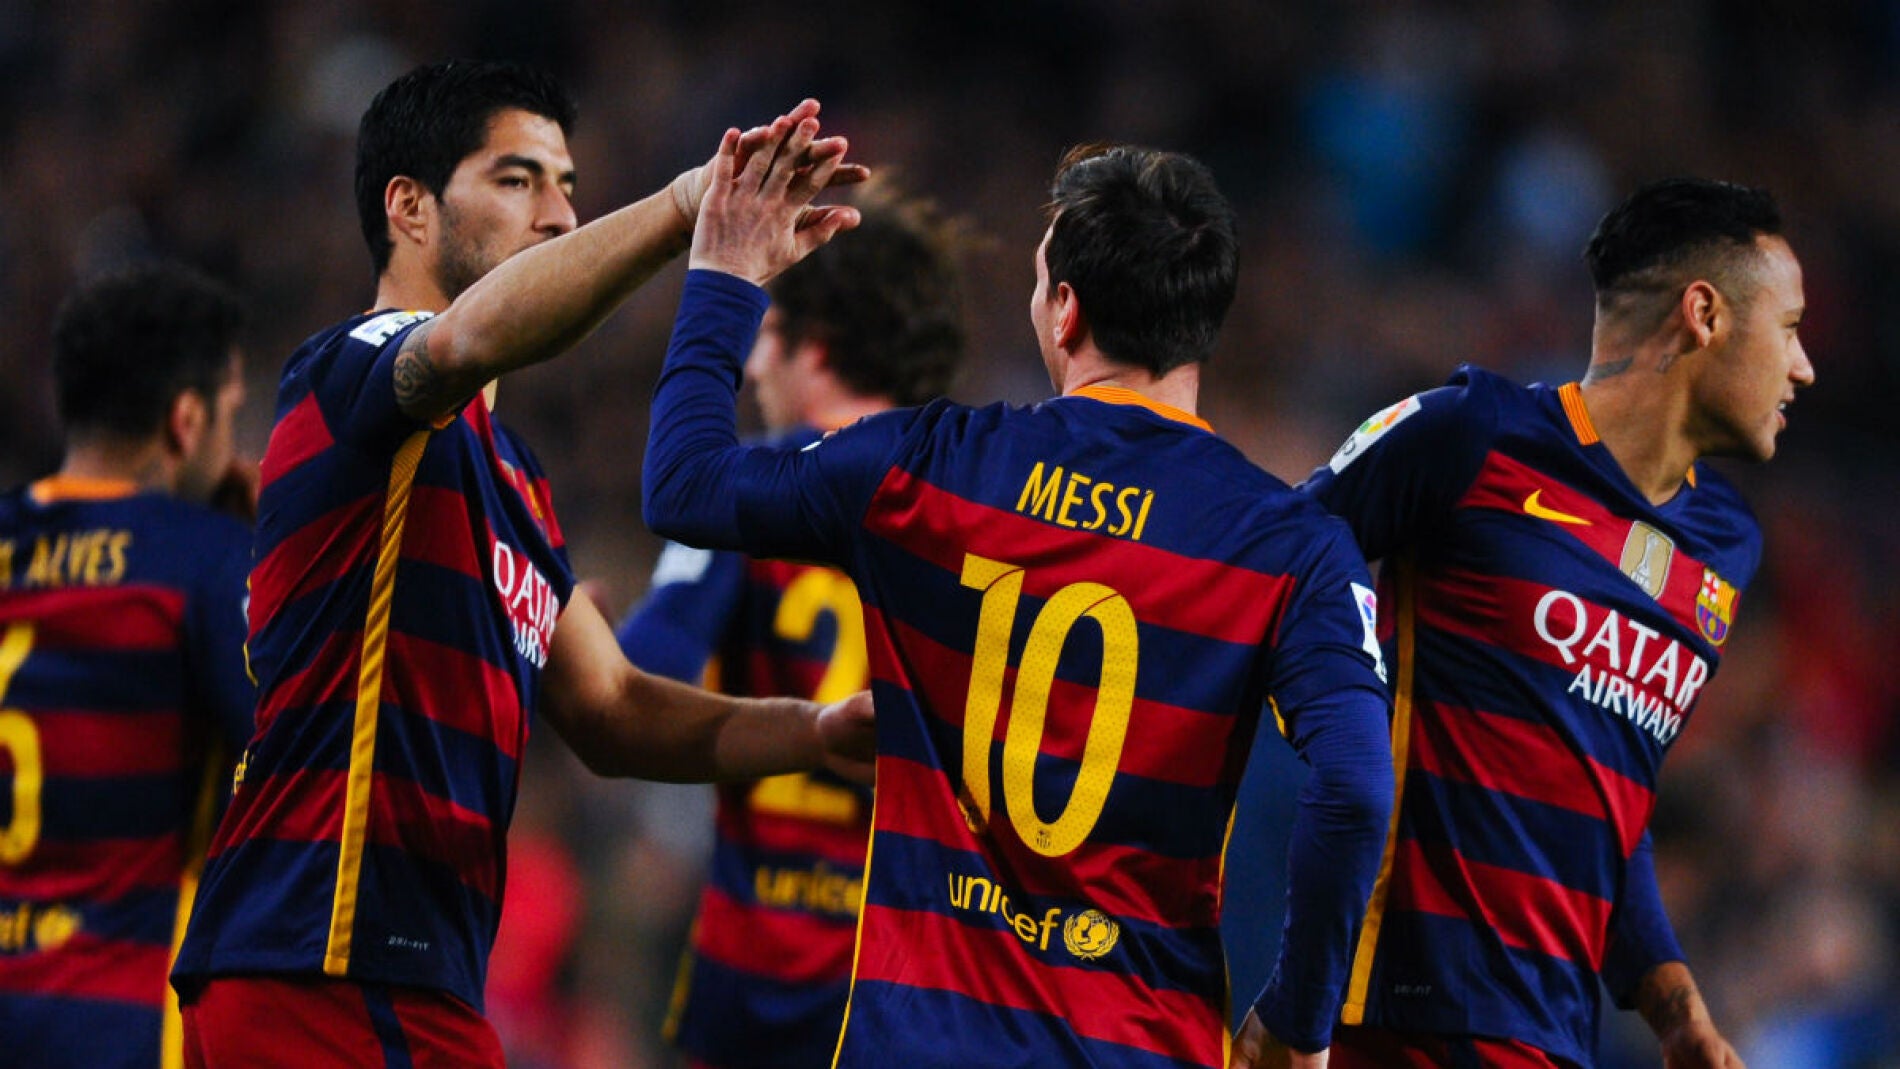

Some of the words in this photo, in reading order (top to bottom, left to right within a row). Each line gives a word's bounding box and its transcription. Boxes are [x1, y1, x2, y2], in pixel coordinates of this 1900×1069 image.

[1015, 461, 1155, 541] MESSI
[24, 530, 131, 586] ALVES
[1534, 590, 1708, 711] QATAR
[958, 552, 1139, 857] 10
[949, 872, 1062, 951] unicef
